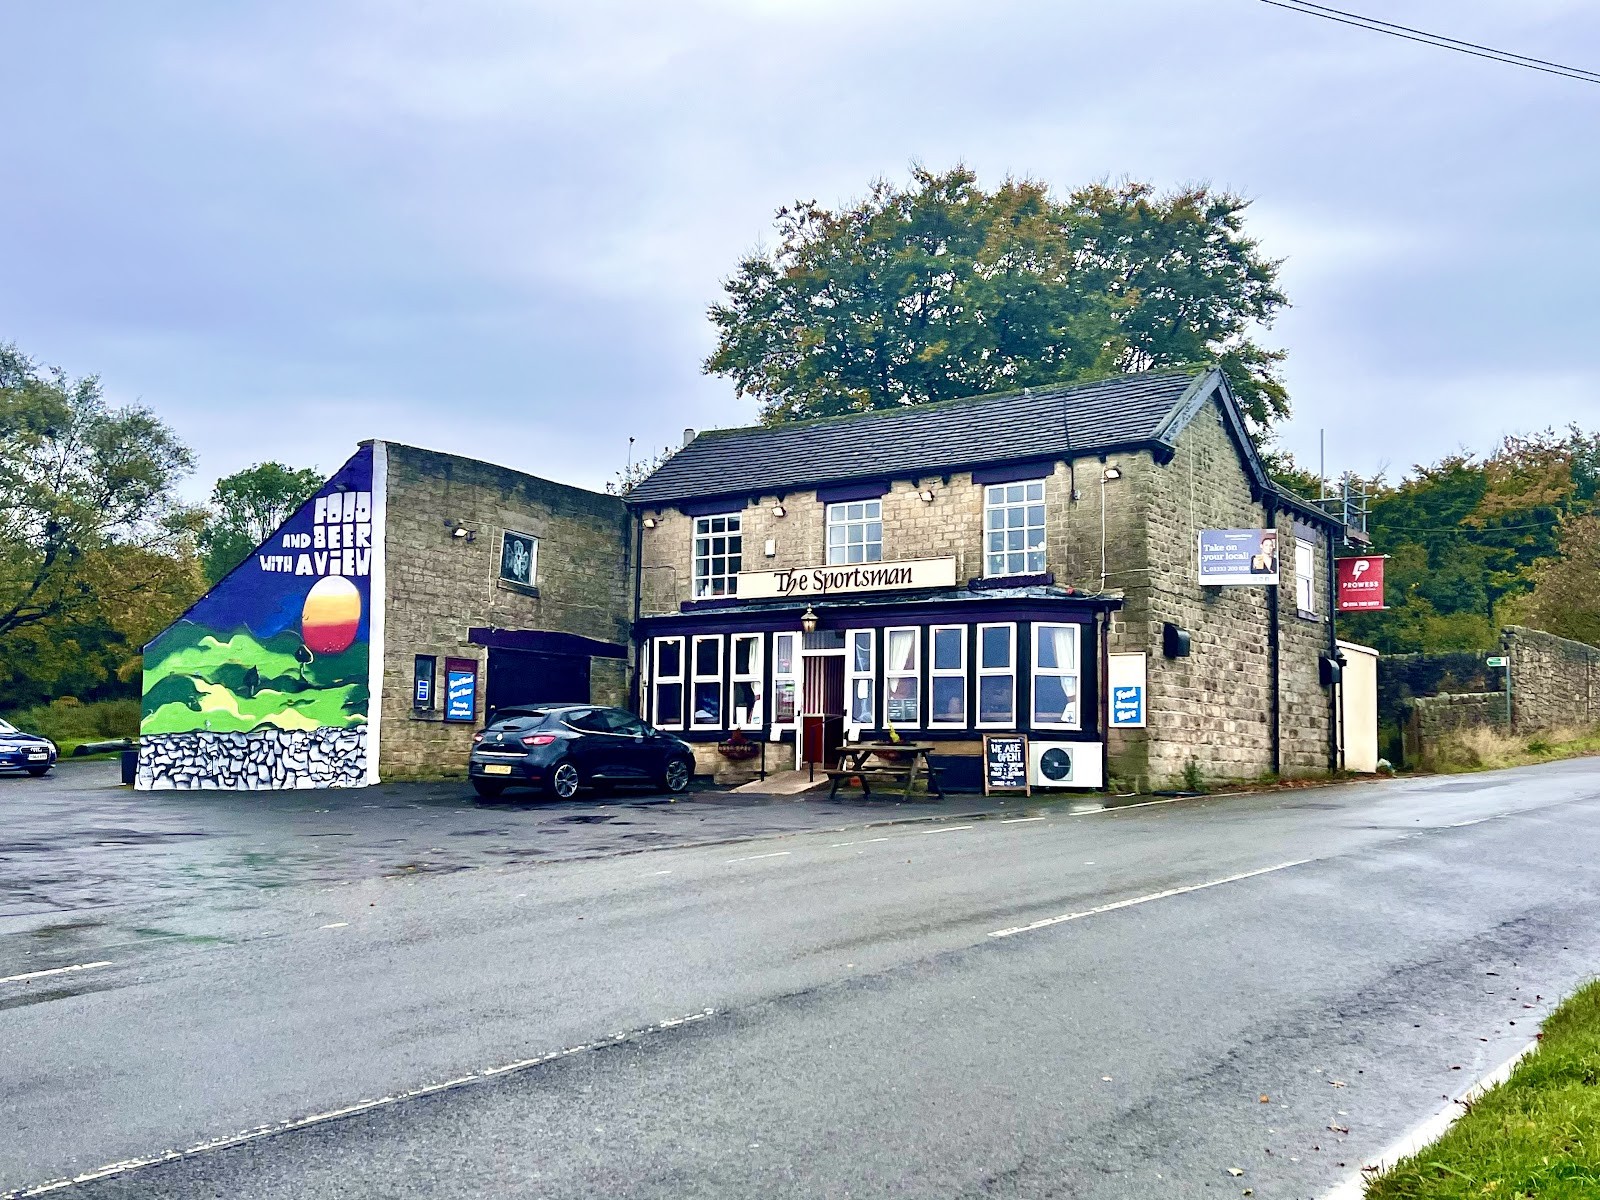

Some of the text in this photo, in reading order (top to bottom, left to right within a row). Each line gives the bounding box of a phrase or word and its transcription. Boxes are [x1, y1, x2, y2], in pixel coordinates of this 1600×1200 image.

[314, 492, 371, 524] FOOD
[282, 523, 371, 549] AND BEER
[1203, 544, 1225, 552] Take
[295, 554, 314, 575] A
[1203, 552, 1249, 562] your local!
[774, 567, 912, 597] The Sportsman
[990, 744, 1021, 753] WE ARE
[997, 752, 1021, 762] OPEN!
